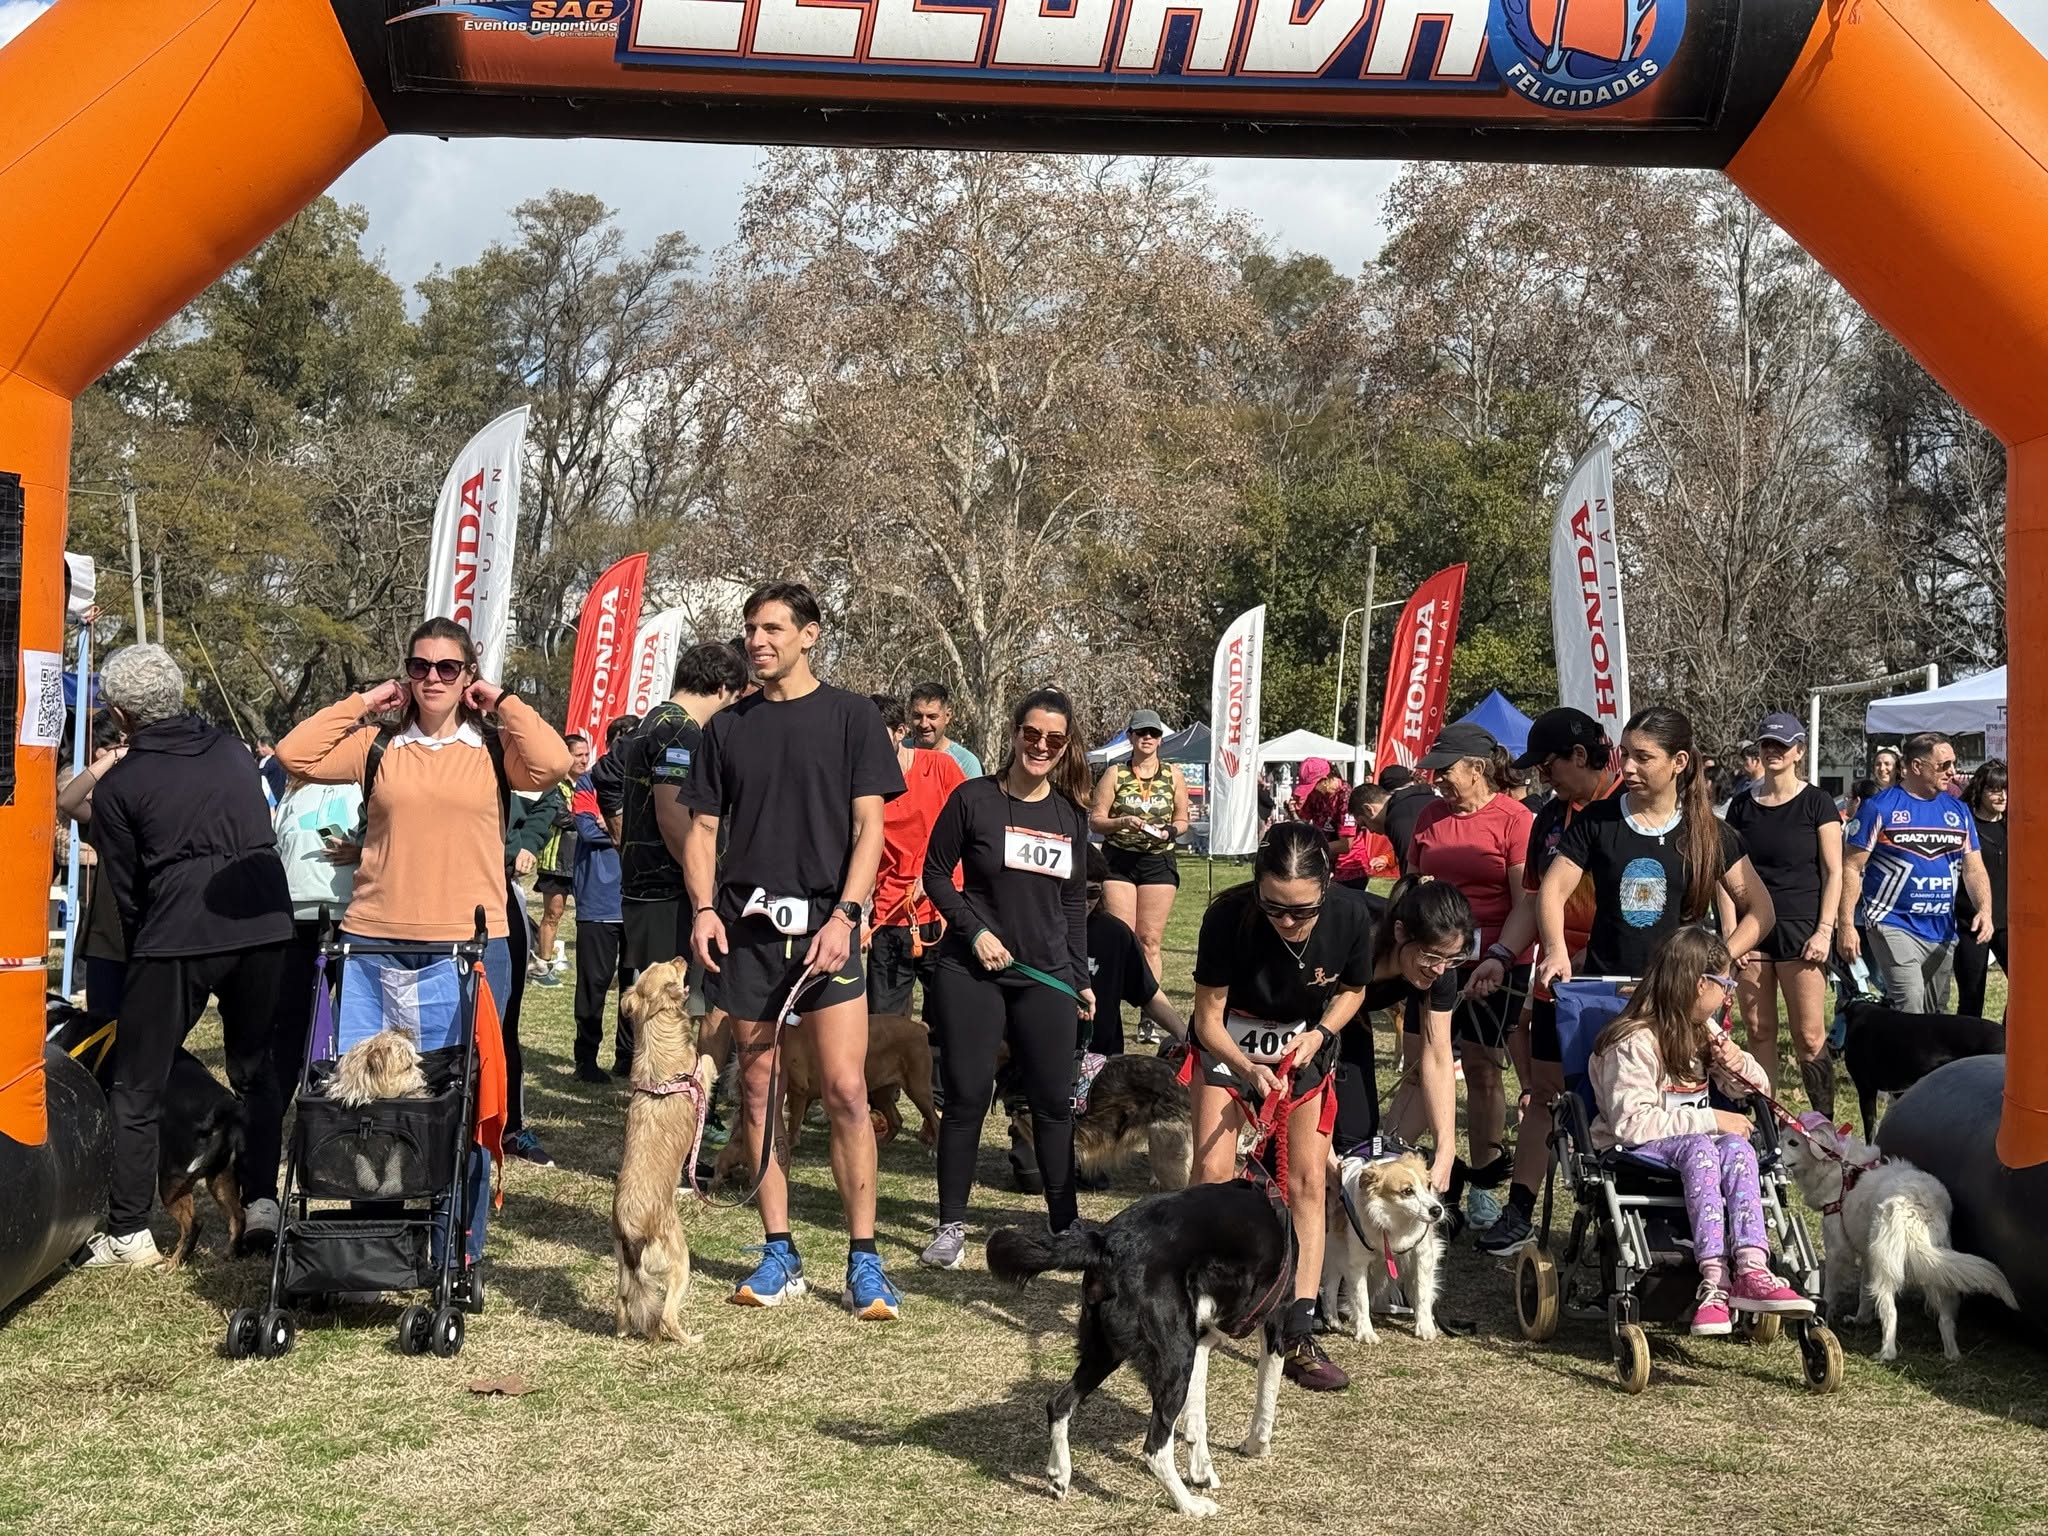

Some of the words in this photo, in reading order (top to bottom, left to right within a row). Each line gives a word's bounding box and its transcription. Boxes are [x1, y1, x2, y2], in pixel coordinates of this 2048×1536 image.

[464, 20, 527, 31] Eventos
[531, 20, 618, 34] Deportivos
[531, 0, 614, 18] SAG
[1506, 59, 1659, 106] FELICIDADES
[453, 467, 484, 640] ONDA
[1571, 500, 1617, 719] HONDA
[590, 586, 620, 728] HONDA
[1433, 600, 1450, 683] LUJÁN
[635, 632, 660, 716] ONDA
[1404, 598, 1436, 741] HONDA
[1228, 635, 1243, 746] HONDA
[1892, 810, 1911, 824] 29
[1017, 843, 1062, 869] 407
[1893, 833, 1931, 844] CRAZY
[1930, 834, 1962, 845] TWINS
[1911, 877, 1952, 891] YPF
[755, 894, 793, 928] 40
[1910, 902, 1950, 915] SMS
